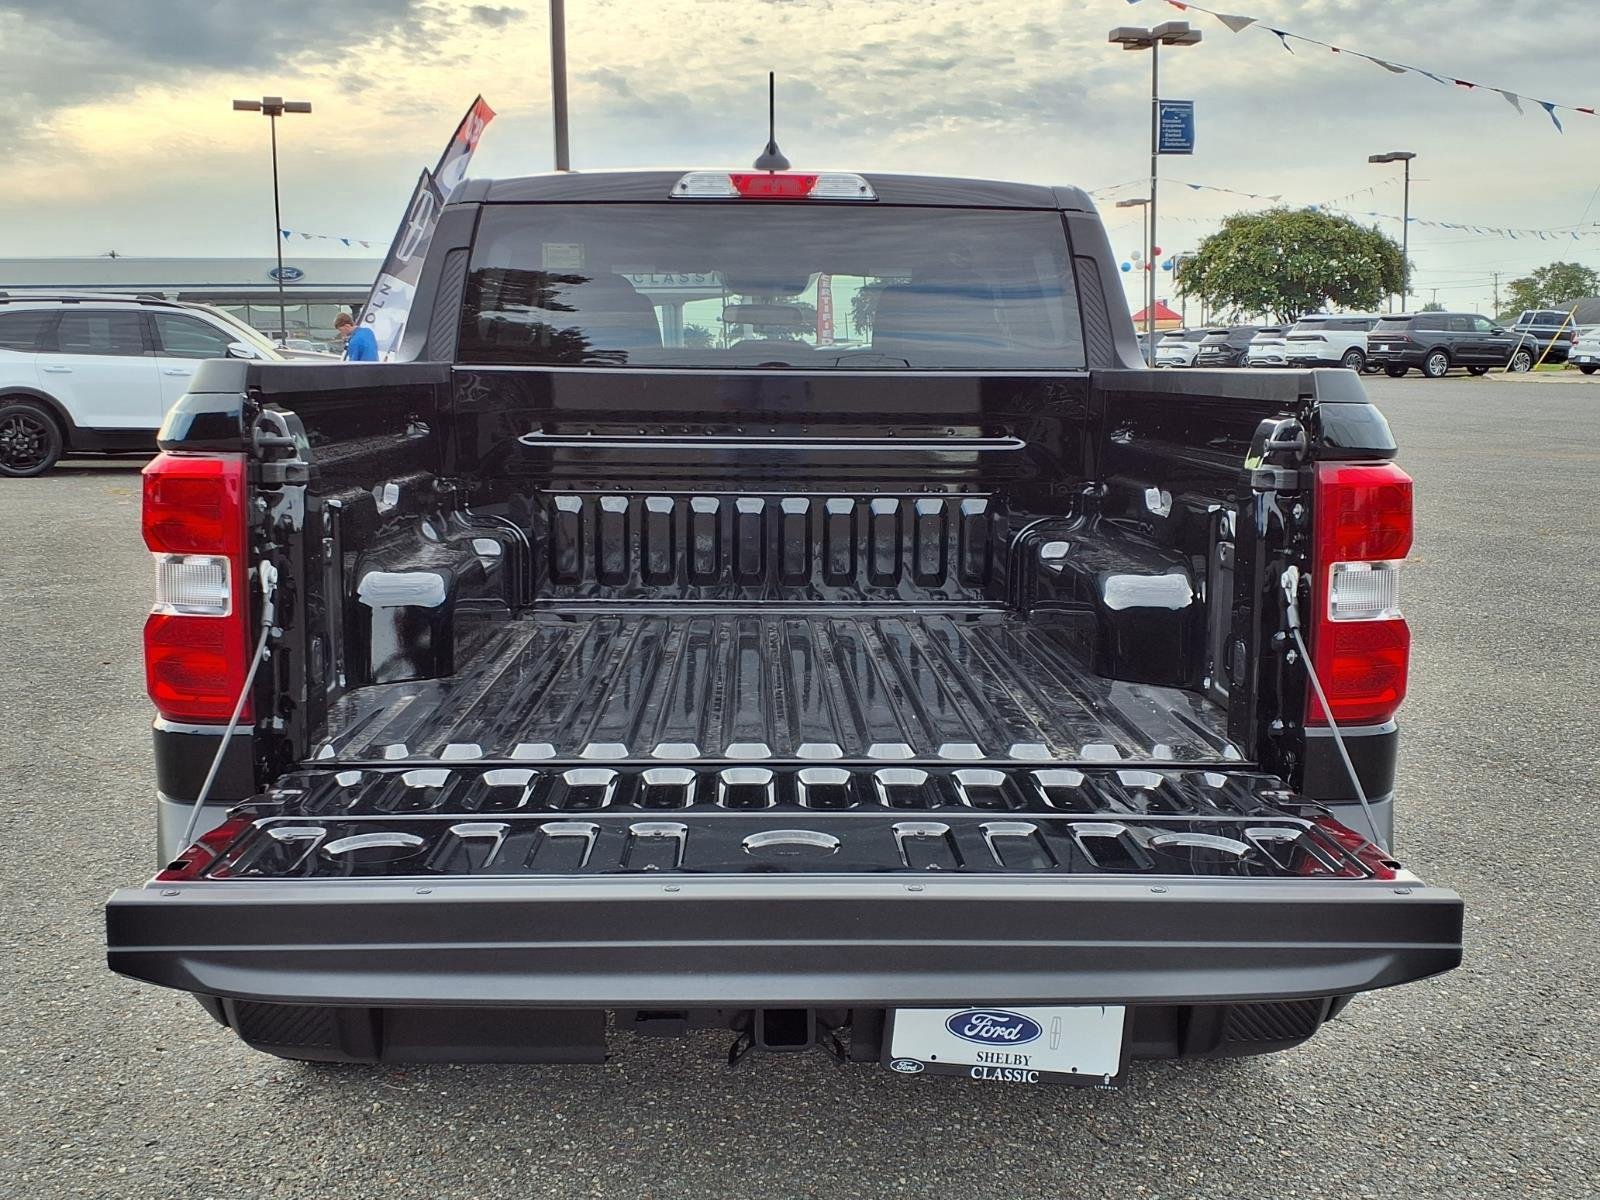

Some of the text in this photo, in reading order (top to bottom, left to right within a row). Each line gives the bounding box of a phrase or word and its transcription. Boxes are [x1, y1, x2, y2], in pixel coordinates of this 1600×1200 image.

[632, 273, 716, 283] CLASSI
[964, 1013, 1023, 1040] Ford
[976, 1051, 1032, 1066] SHELBY
[896, 1062, 918, 1072] Ford
[971, 1067, 1039, 1083] CLASSIC
